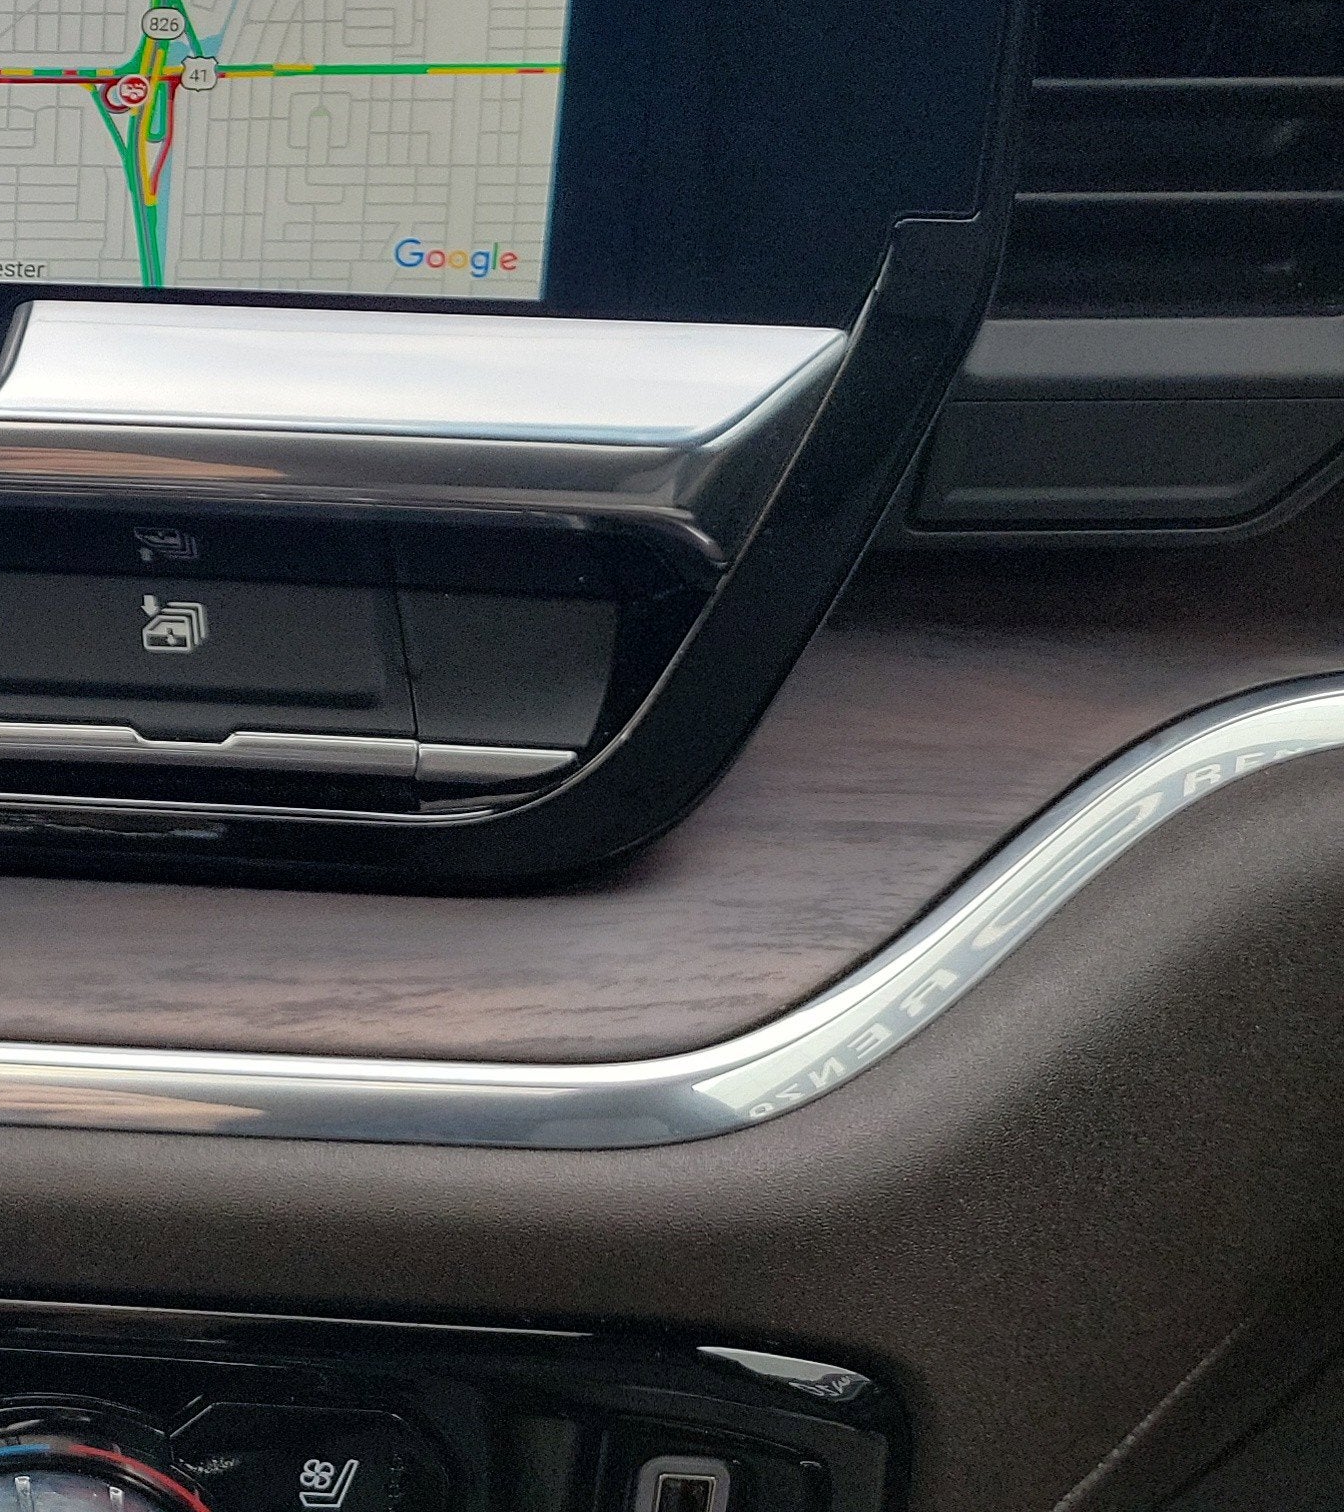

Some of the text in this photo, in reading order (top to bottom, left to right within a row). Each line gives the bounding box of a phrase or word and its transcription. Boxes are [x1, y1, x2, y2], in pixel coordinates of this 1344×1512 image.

[148, 15, 179, 33] 826
[189, 68, 209, 84] 41
[394, 238, 519, 278] Google
